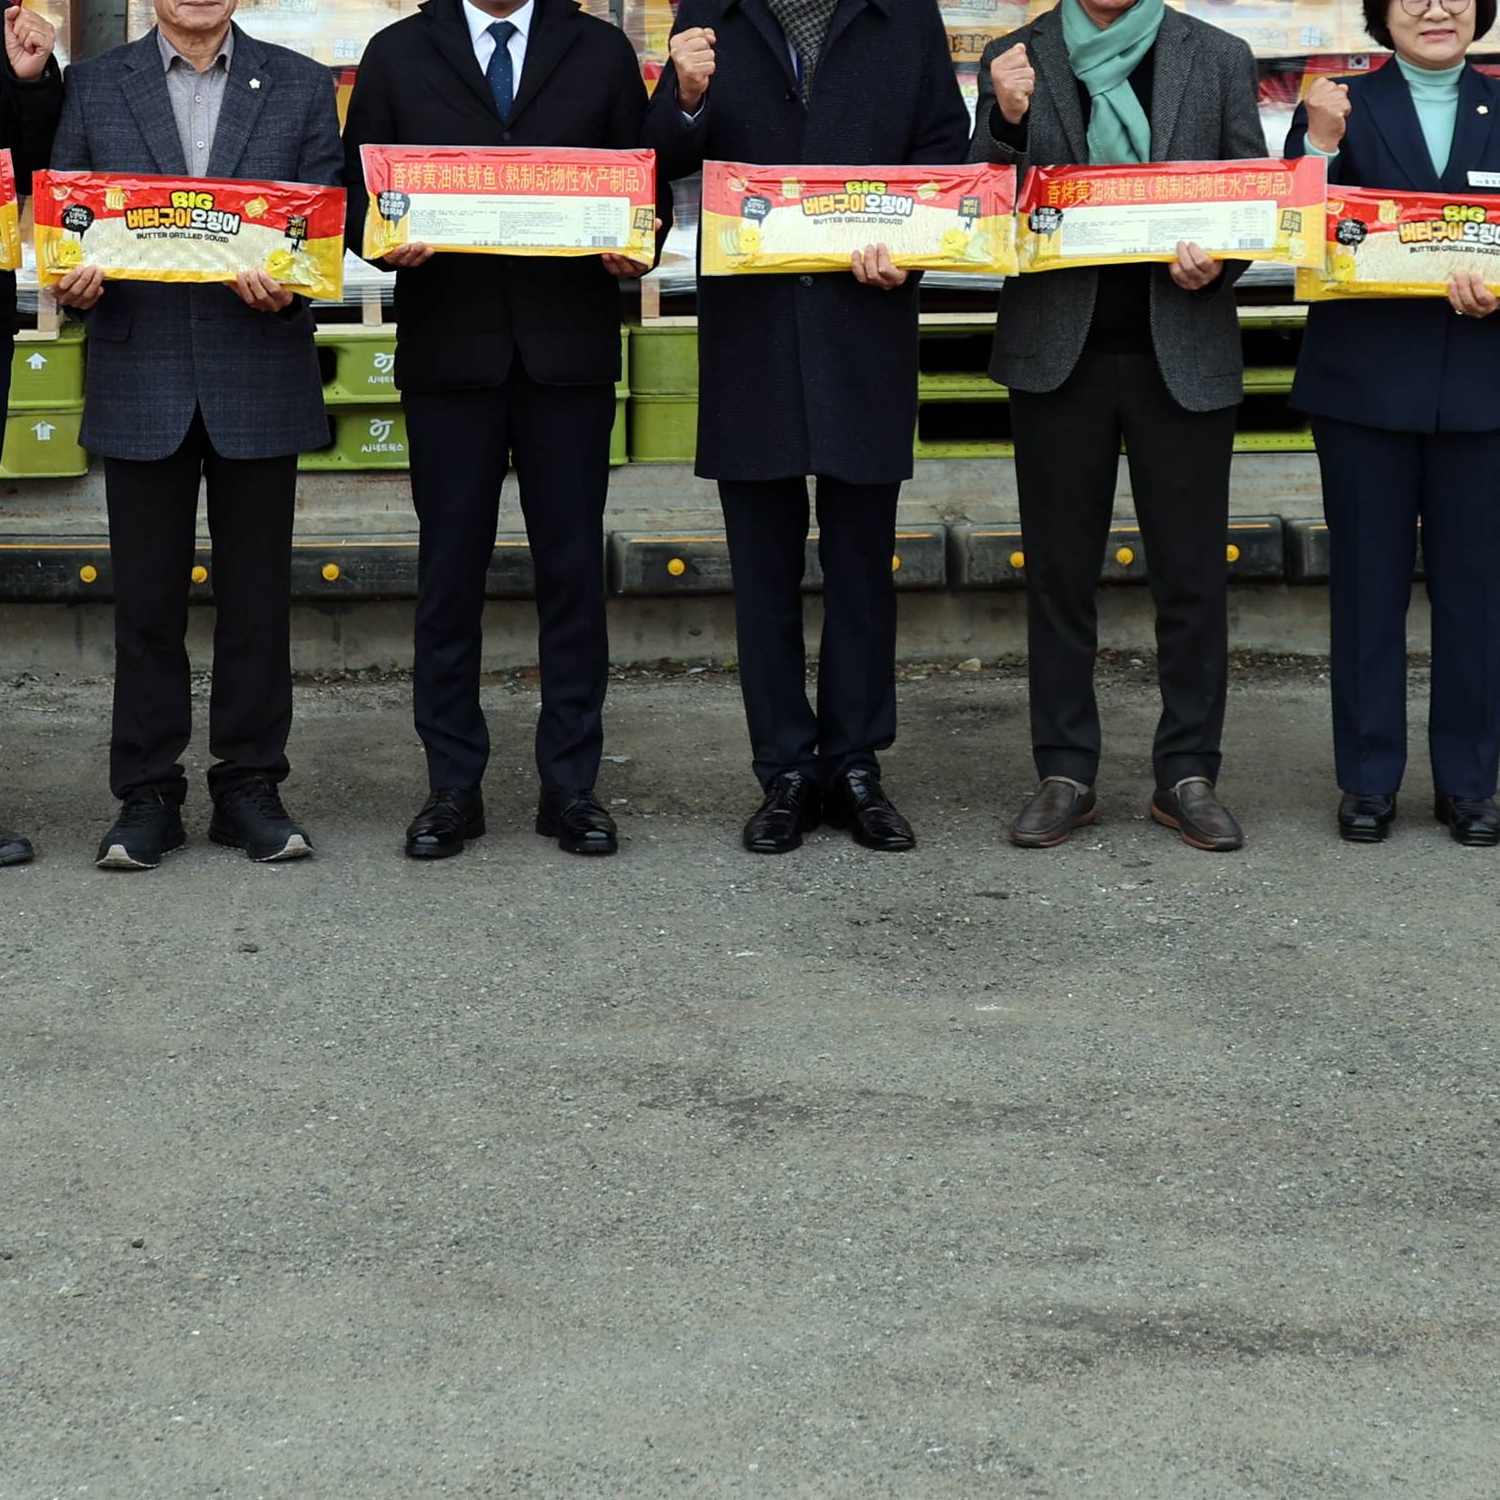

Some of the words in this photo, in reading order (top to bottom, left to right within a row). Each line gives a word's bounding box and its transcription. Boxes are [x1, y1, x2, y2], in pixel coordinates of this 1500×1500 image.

[844, 180, 888, 196] BIG
[170, 191, 215, 210] BIG
[802, 192, 915, 218] 버터구이오징어
[125, 207, 242, 235] 버터구이오징어
[1442, 204, 1488, 223] BIG
